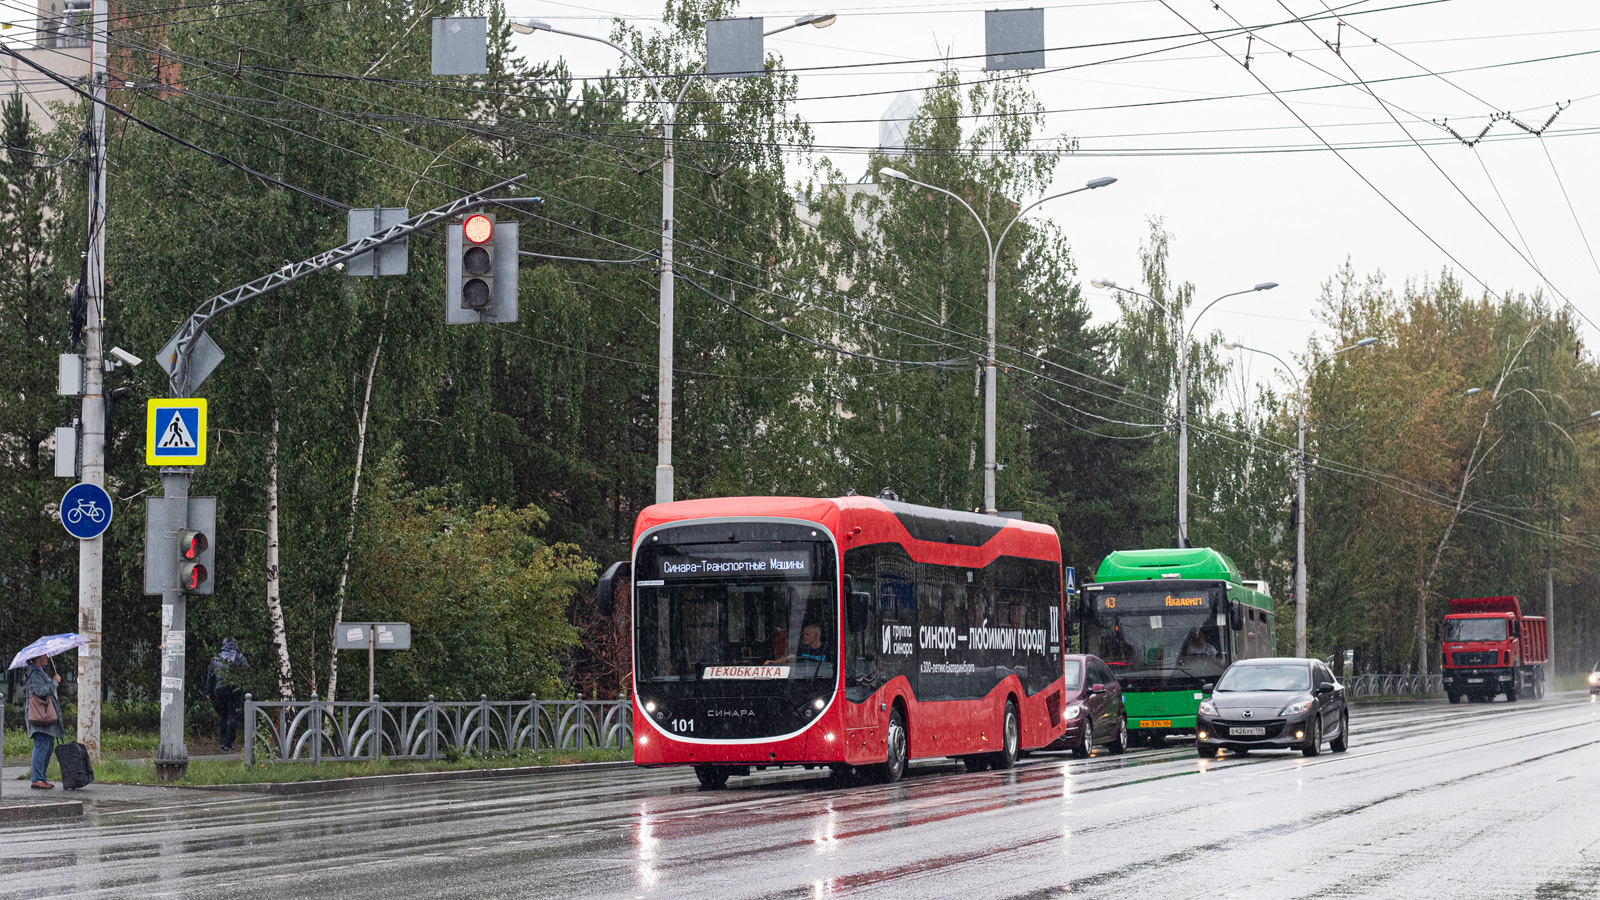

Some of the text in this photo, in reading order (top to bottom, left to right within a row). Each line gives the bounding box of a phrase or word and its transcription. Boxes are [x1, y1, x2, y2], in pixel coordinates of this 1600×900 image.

[663, 558, 805, 573] Синара-Транспортные Машины
[1105, 597, 1116, 608] 43
[892, 625, 912, 640] группа
[919, 625, 956, 656] синара
[969, 618, 1017, 656] любимому
[1017, 629, 1047, 656] городу
[893, 643, 913, 658] синара
[709, 666, 781, 678] ТЕХОБКАТКА
[707, 709, 756, 717] СИНАРА
[671, 719, 695, 732] 101
